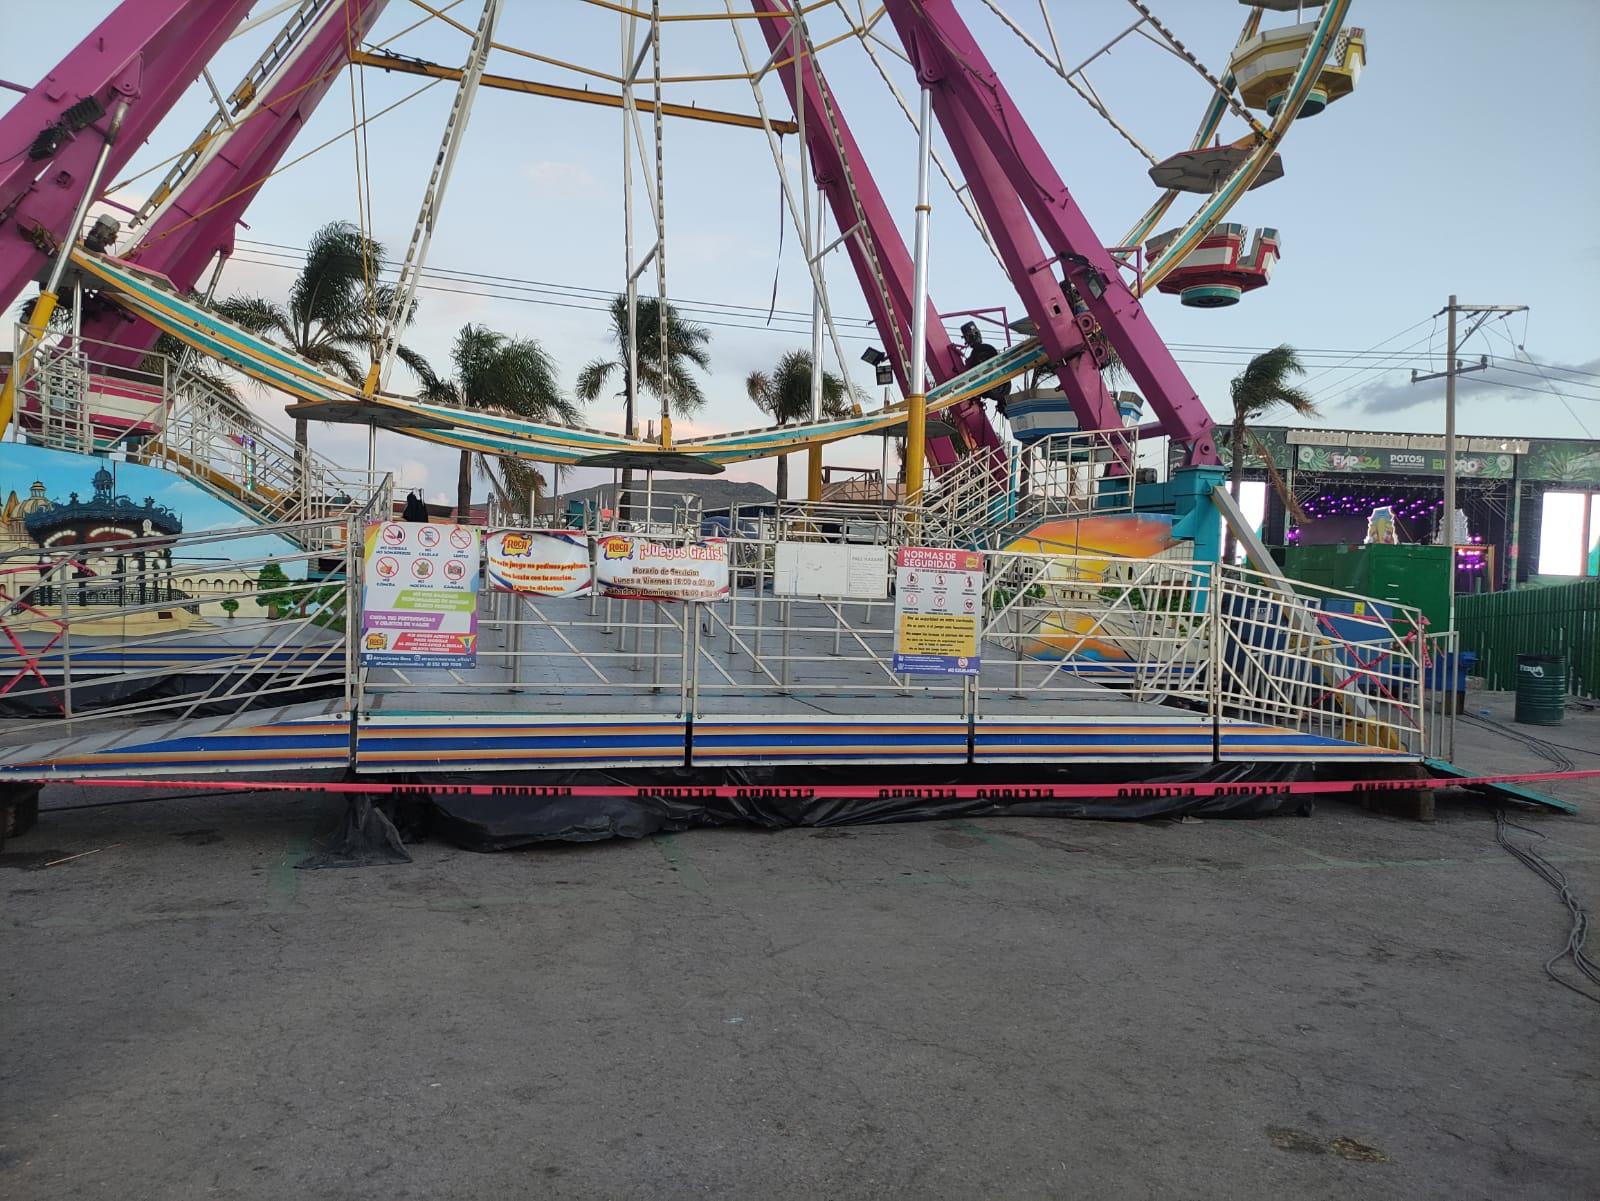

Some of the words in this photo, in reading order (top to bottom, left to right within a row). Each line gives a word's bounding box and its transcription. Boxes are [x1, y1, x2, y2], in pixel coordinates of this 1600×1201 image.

[609, 543, 628, 552] ROCA
[640, 544, 686, 560] ¡Juegos
[689, 544, 723, 560] Gratis!
[904, 550, 944, 560] NORMAS
[904, 559, 956, 568] SEGURIDAD
[632, 566, 659, 576] Horario
[612, 576, 634, 585] Lunes
